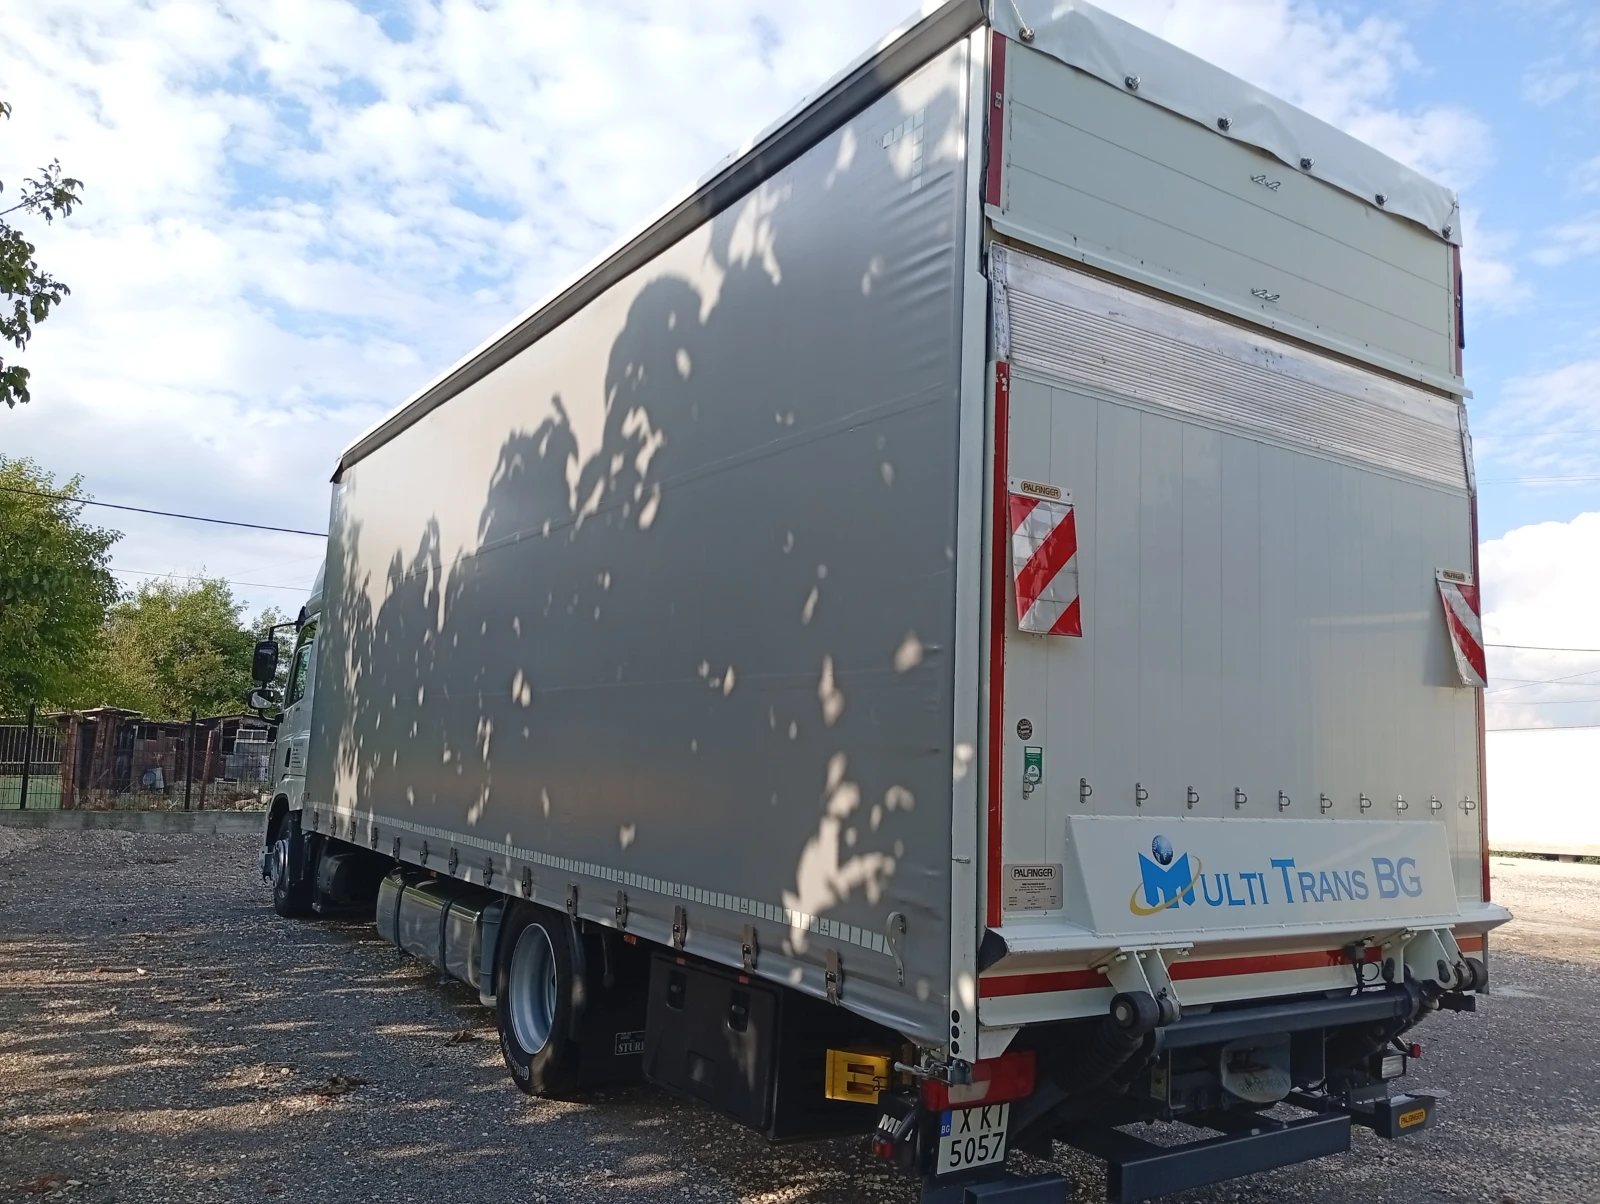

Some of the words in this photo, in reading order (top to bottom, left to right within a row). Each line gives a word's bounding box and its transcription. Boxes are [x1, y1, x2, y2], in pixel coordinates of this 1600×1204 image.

[1023, 482, 1060, 498] PALFINGER
[1013, 868, 1053, 878] PALFINGER
[1137, 852, 1270, 909] MULTI
[1270, 857, 1370, 904] TRANS
[1371, 857, 1423, 899] BG
[941, 1124, 951, 1134] BG
[949, 1131, 1004, 1167] 5057
